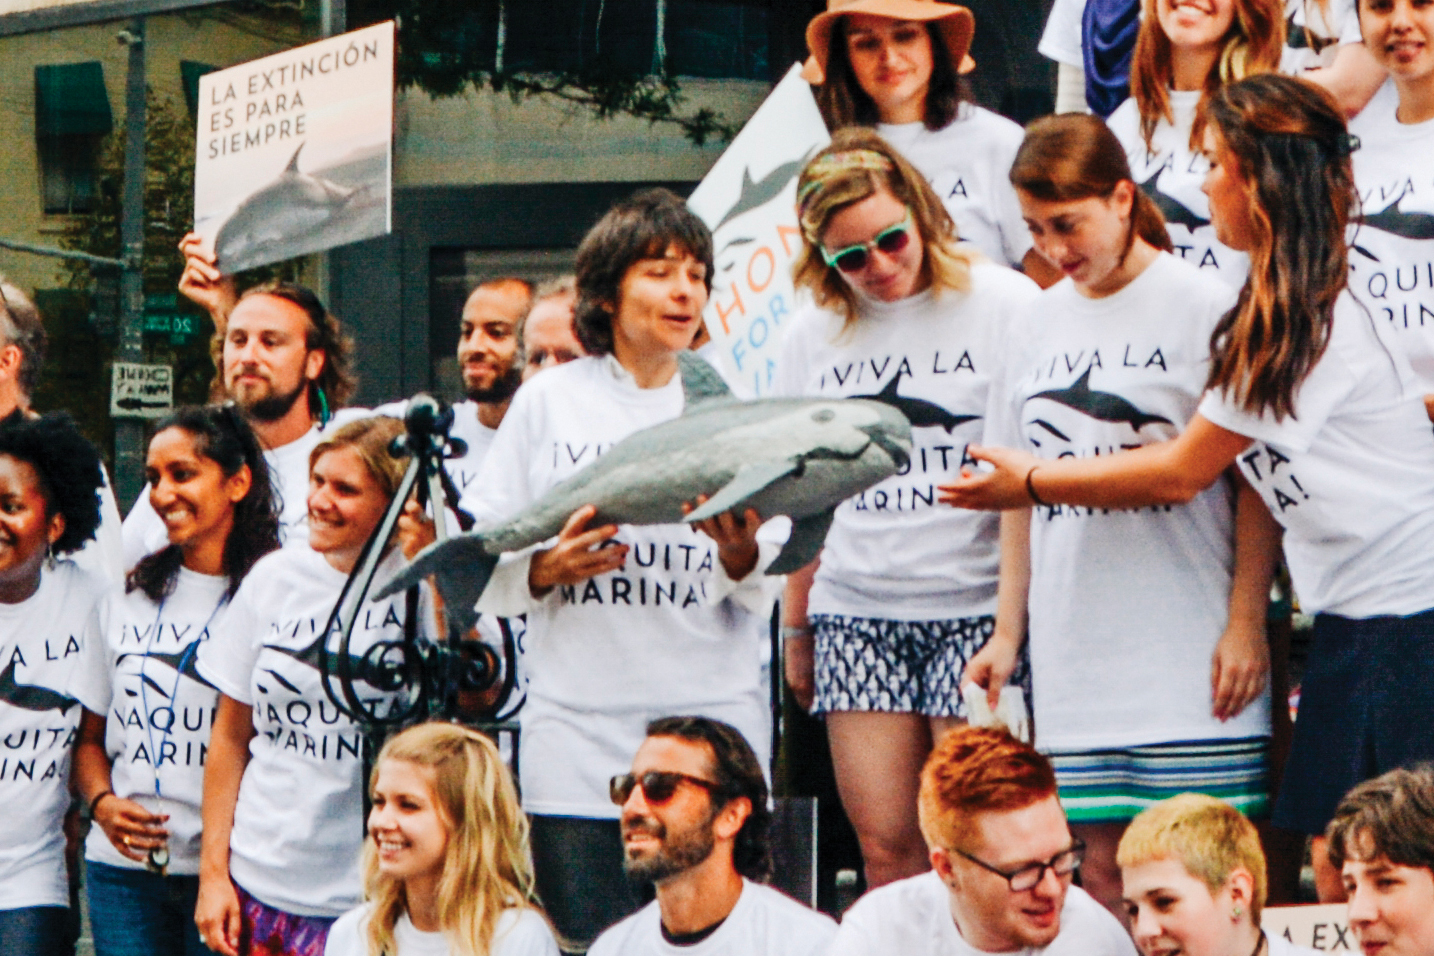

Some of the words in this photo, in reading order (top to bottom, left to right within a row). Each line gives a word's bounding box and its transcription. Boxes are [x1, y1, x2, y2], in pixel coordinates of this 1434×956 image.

[211, 82, 236, 106] LA
[248, 39, 378, 95] EXTINCIÓN
[210, 108, 234, 133] ES
[246, 89, 305, 122] PARA
[208, 113, 307, 159] SIEMPRE
[946, 177, 968, 199] A
[732, 293, 790, 372] FOR
[932, 349, 976, 375] LA
[1122, 342, 1168, 373] LA
[856, 484, 934, 512] ARIN
[364, 602, 403, 631] LA
[45, 633, 81, 662] LA
[4, 725, 77, 750] UITA
